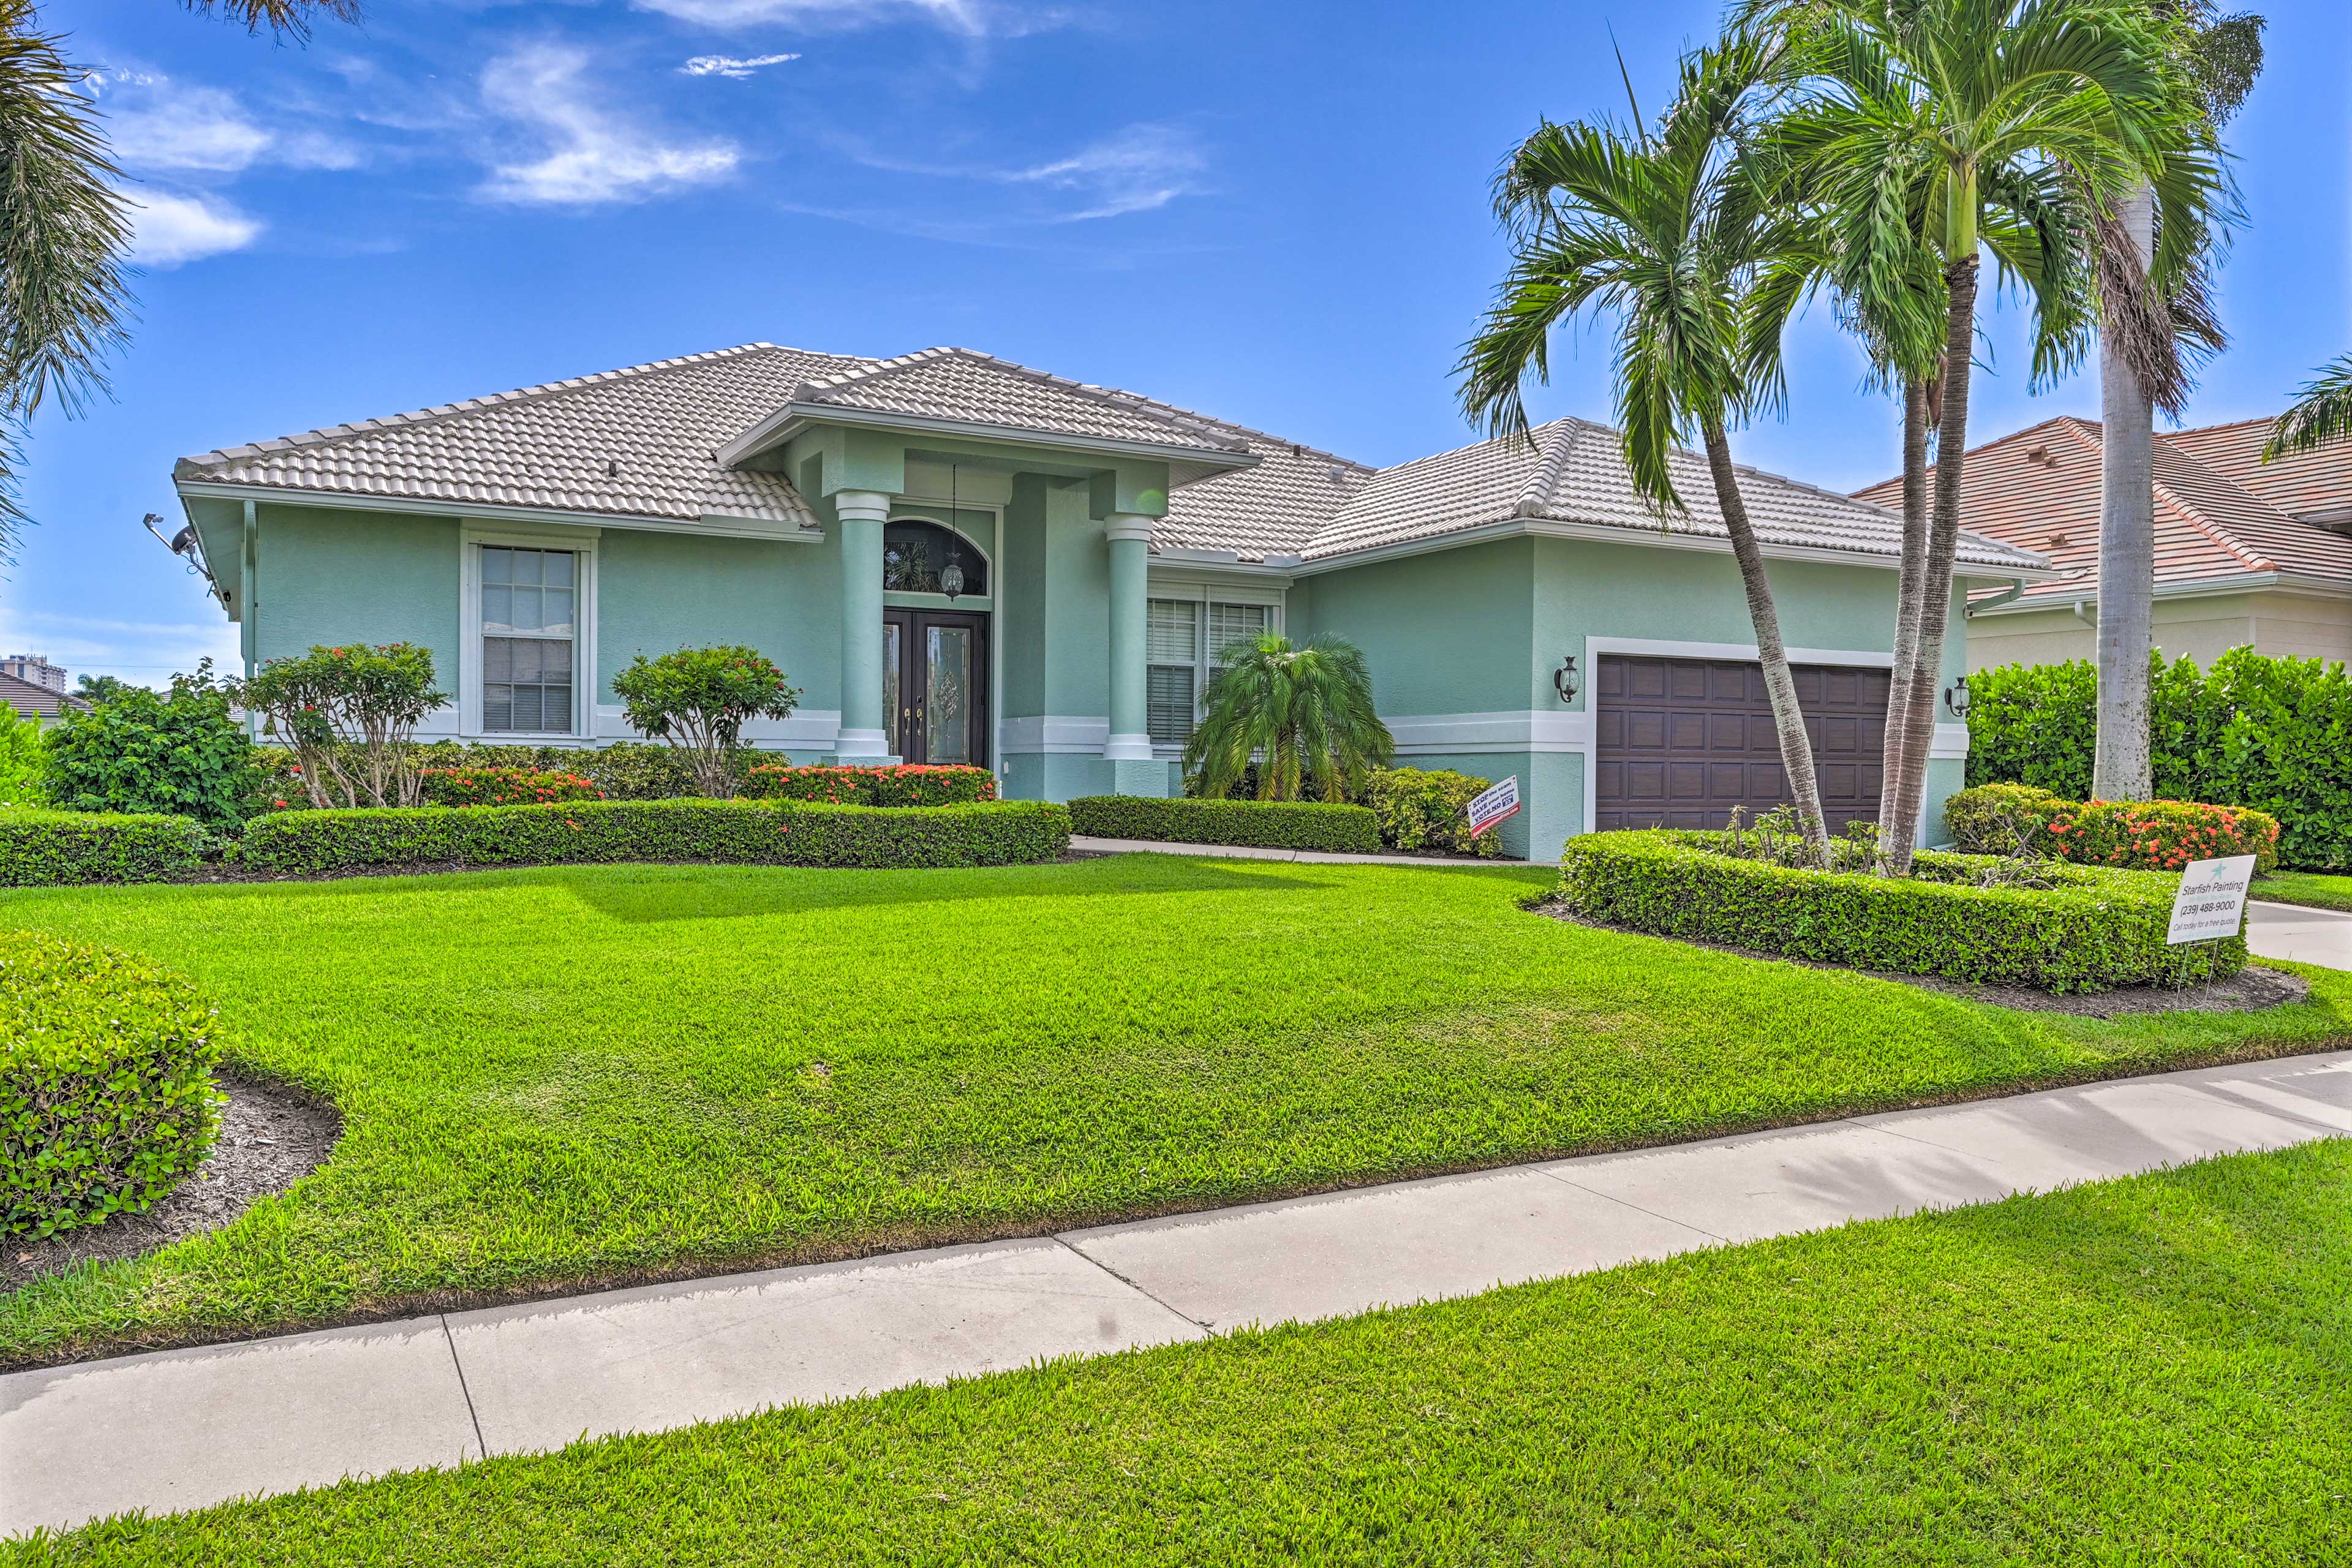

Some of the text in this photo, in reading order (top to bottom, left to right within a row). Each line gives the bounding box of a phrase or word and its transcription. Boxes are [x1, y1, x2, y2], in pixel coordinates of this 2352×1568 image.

[1471, 788, 1515, 817] SAVE your home
[1472, 794, 1488, 808] STOP
[1498, 782, 1512, 792] scam
[1475, 802, 1501, 822] VOTE NO
[2182, 880, 2244, 895] Starfish Painting
[2180, 900, 2235, 917] (239) 488-9000
[2184, 921, 2197, 930] today
[2209, 919, 2219, 927] free
